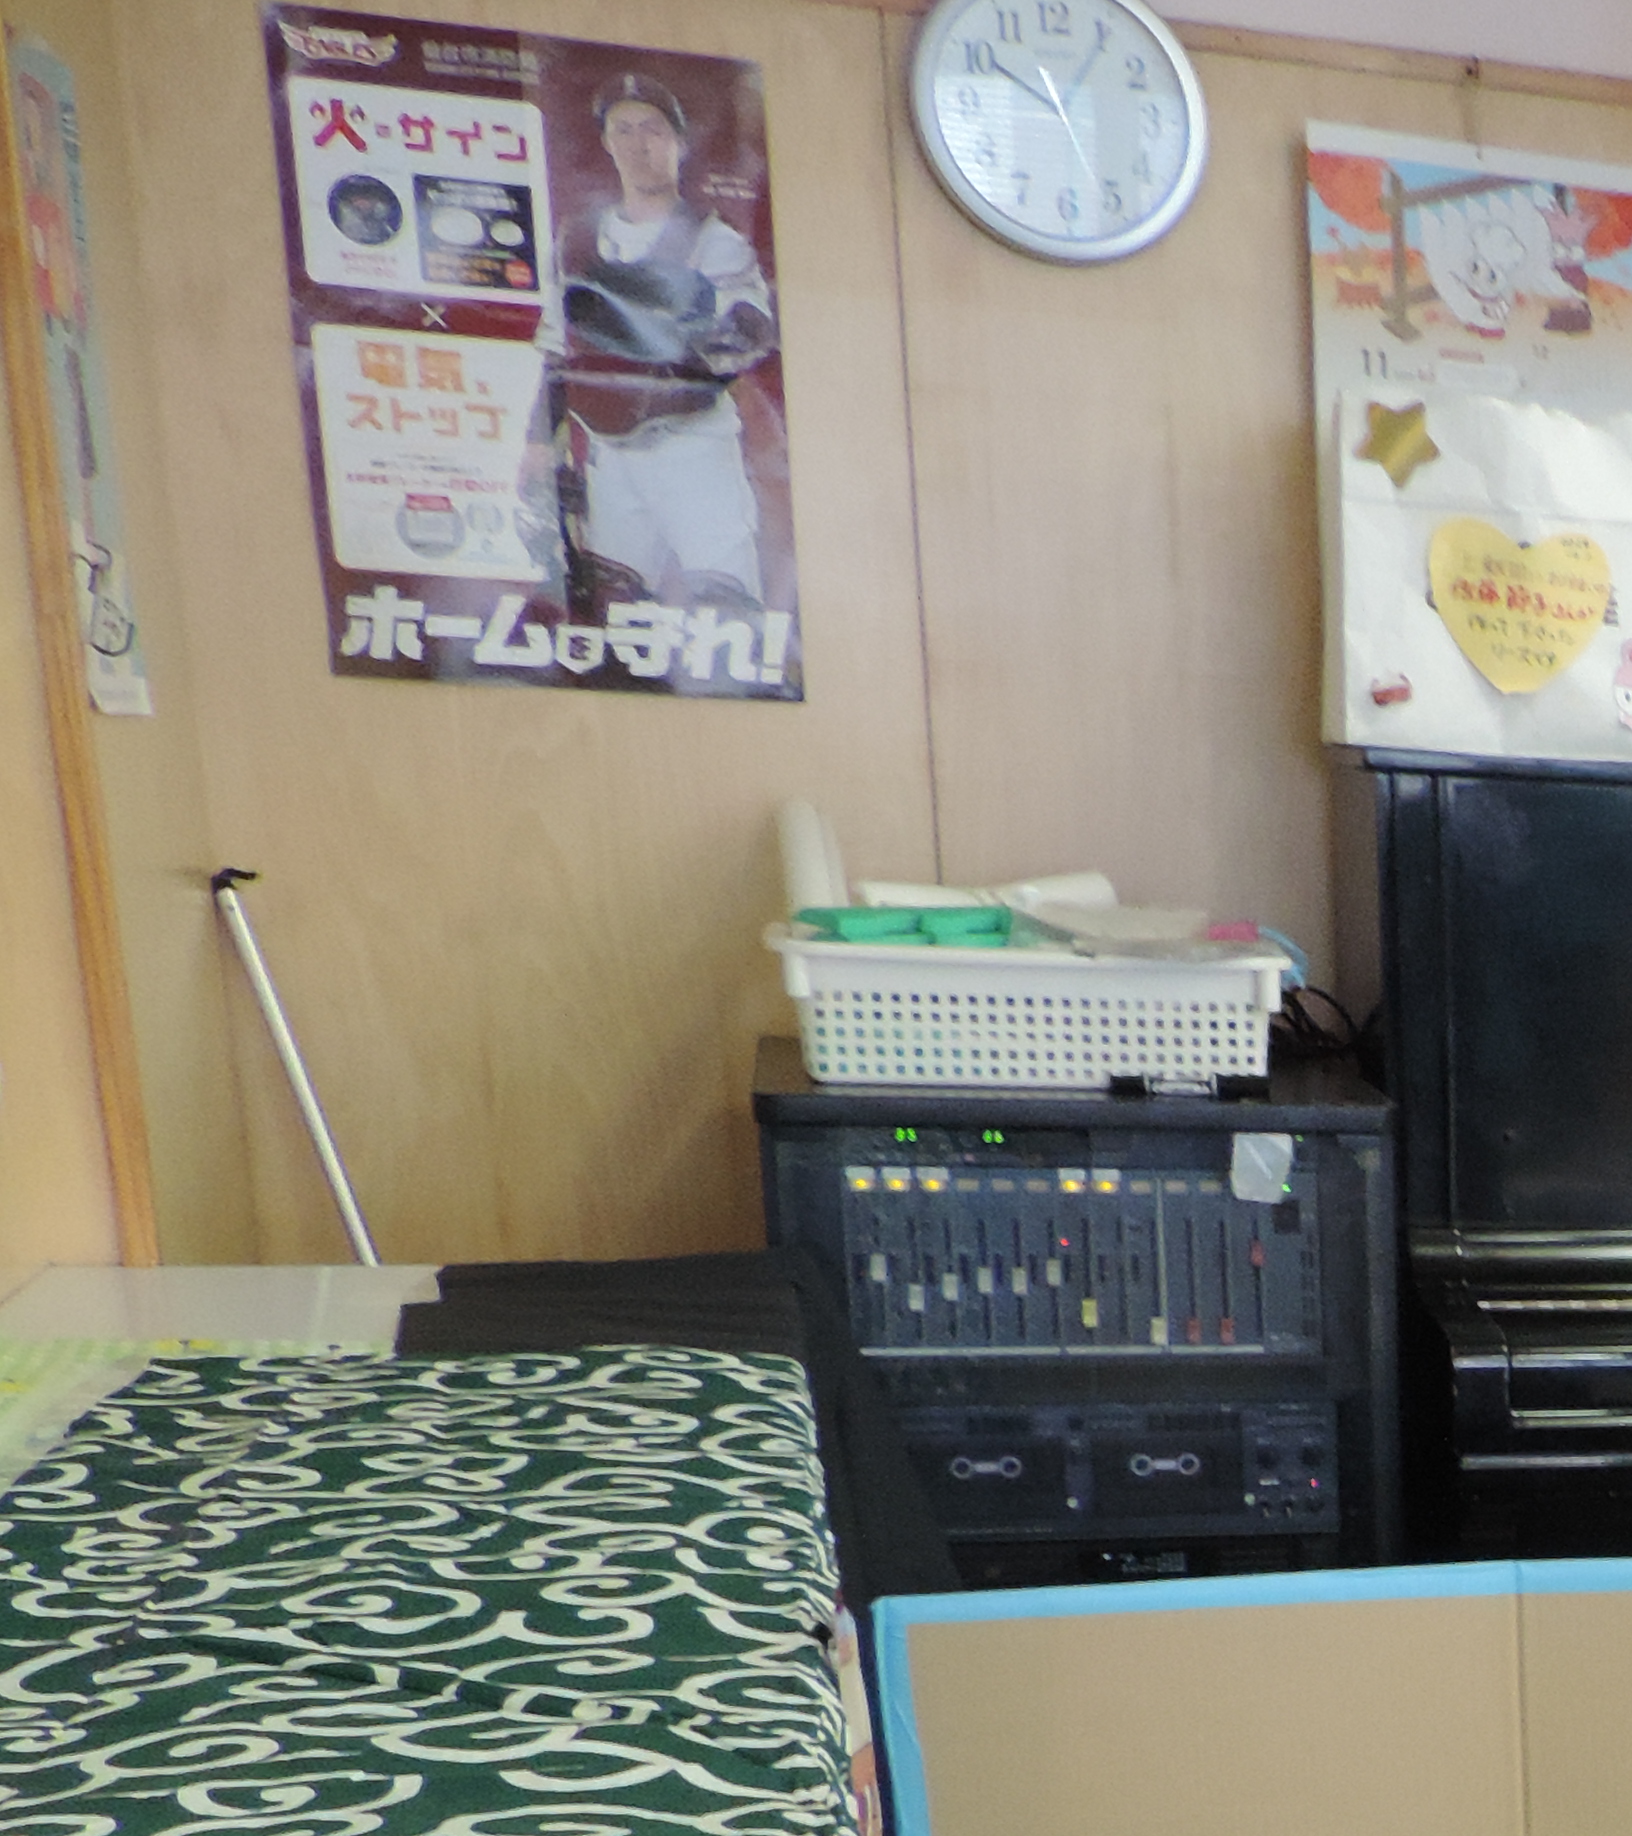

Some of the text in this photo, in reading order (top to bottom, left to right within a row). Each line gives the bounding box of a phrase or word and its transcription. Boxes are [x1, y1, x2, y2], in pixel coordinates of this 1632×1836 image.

[997, 9, 1022, 43] 11
[1037, 1, 1071, 36] 12
[964, 39, 995, 75] 10
[1125, 56, 1147, 91] 2
[1057, 186, 1079, 221] 6
